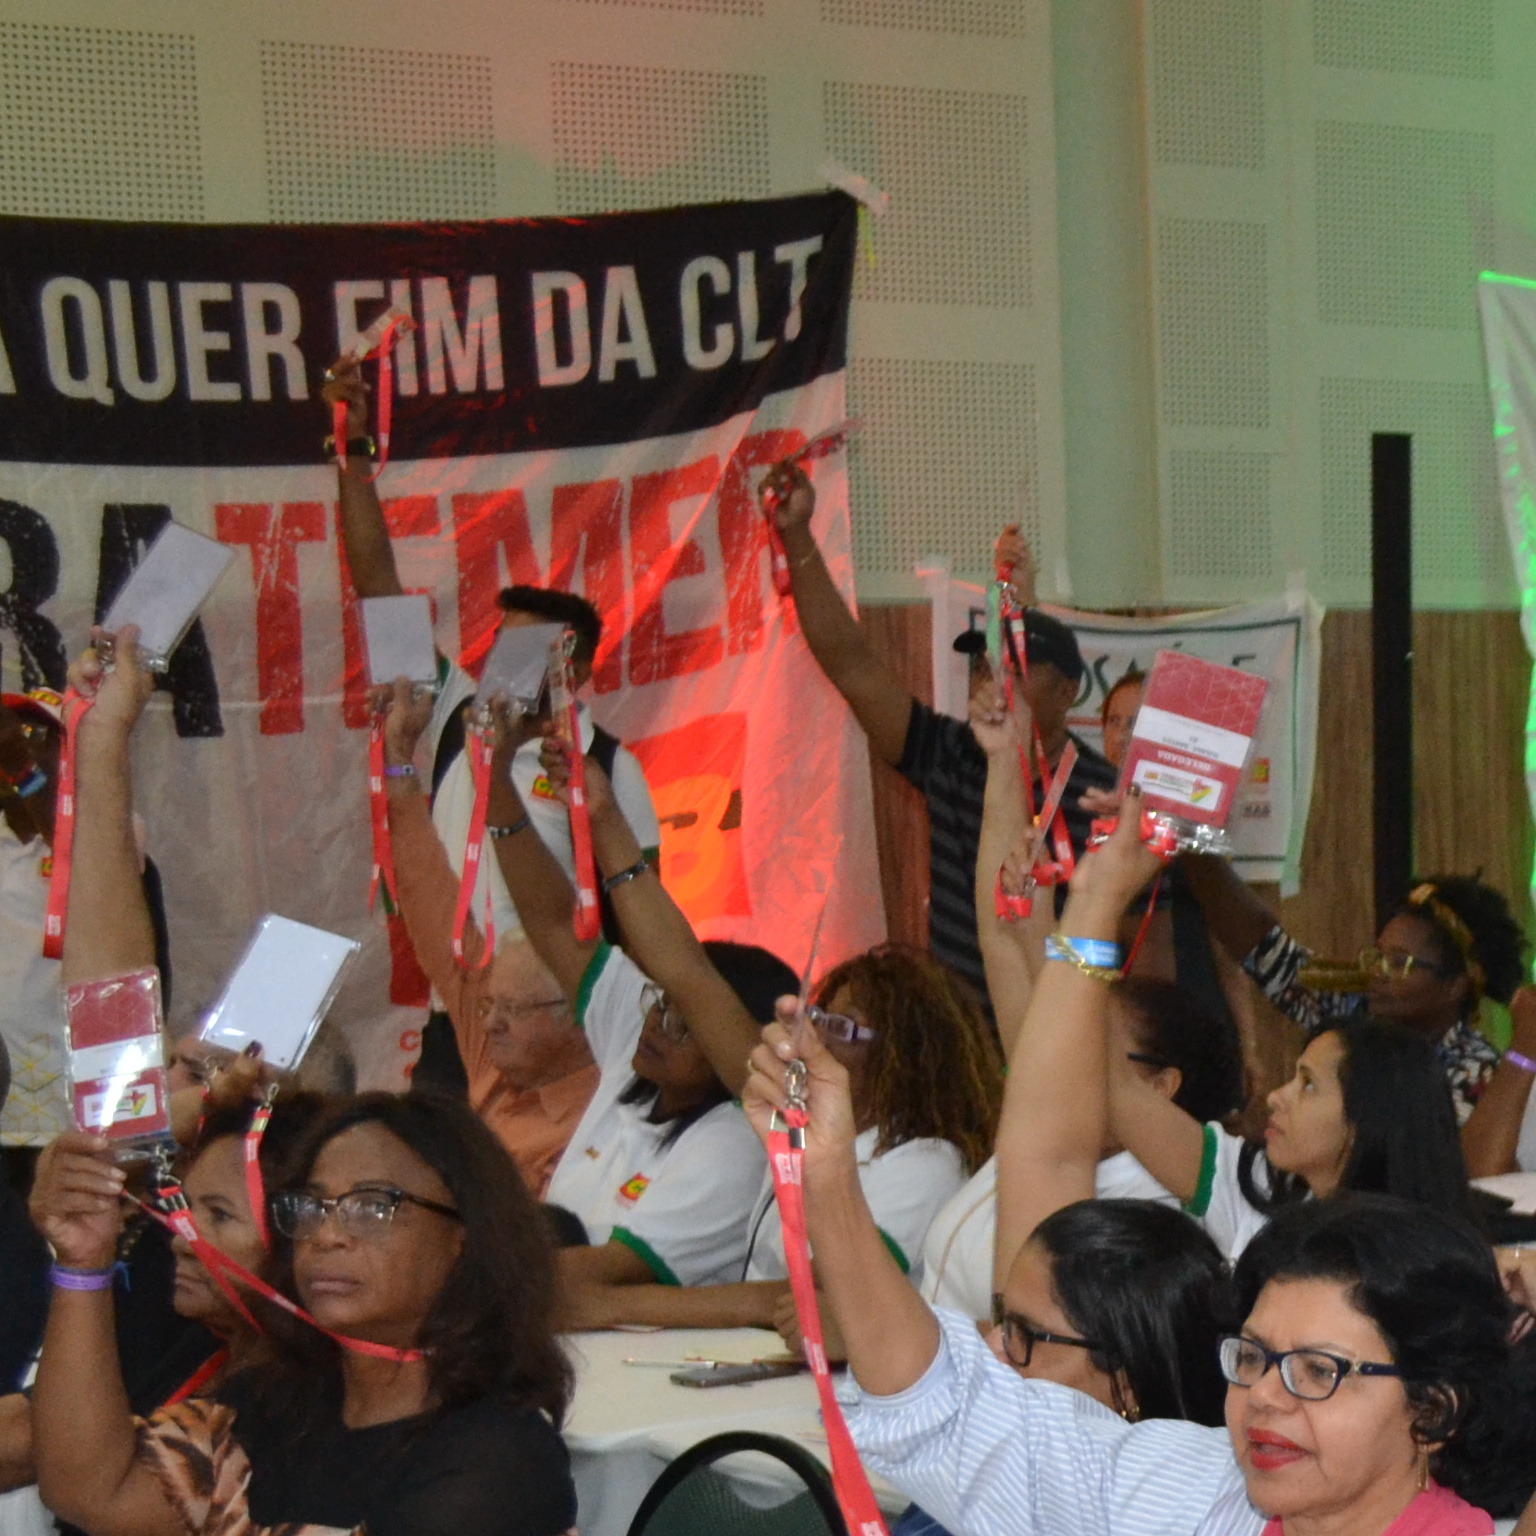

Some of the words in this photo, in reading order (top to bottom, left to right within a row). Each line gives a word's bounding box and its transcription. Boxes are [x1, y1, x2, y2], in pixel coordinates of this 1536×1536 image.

[40, 276, 310, 405] QUER
[333, 274, 506, 393] FIM
[531, 265, 656, 386] DA
[679, 235, 824, 371] CLT
